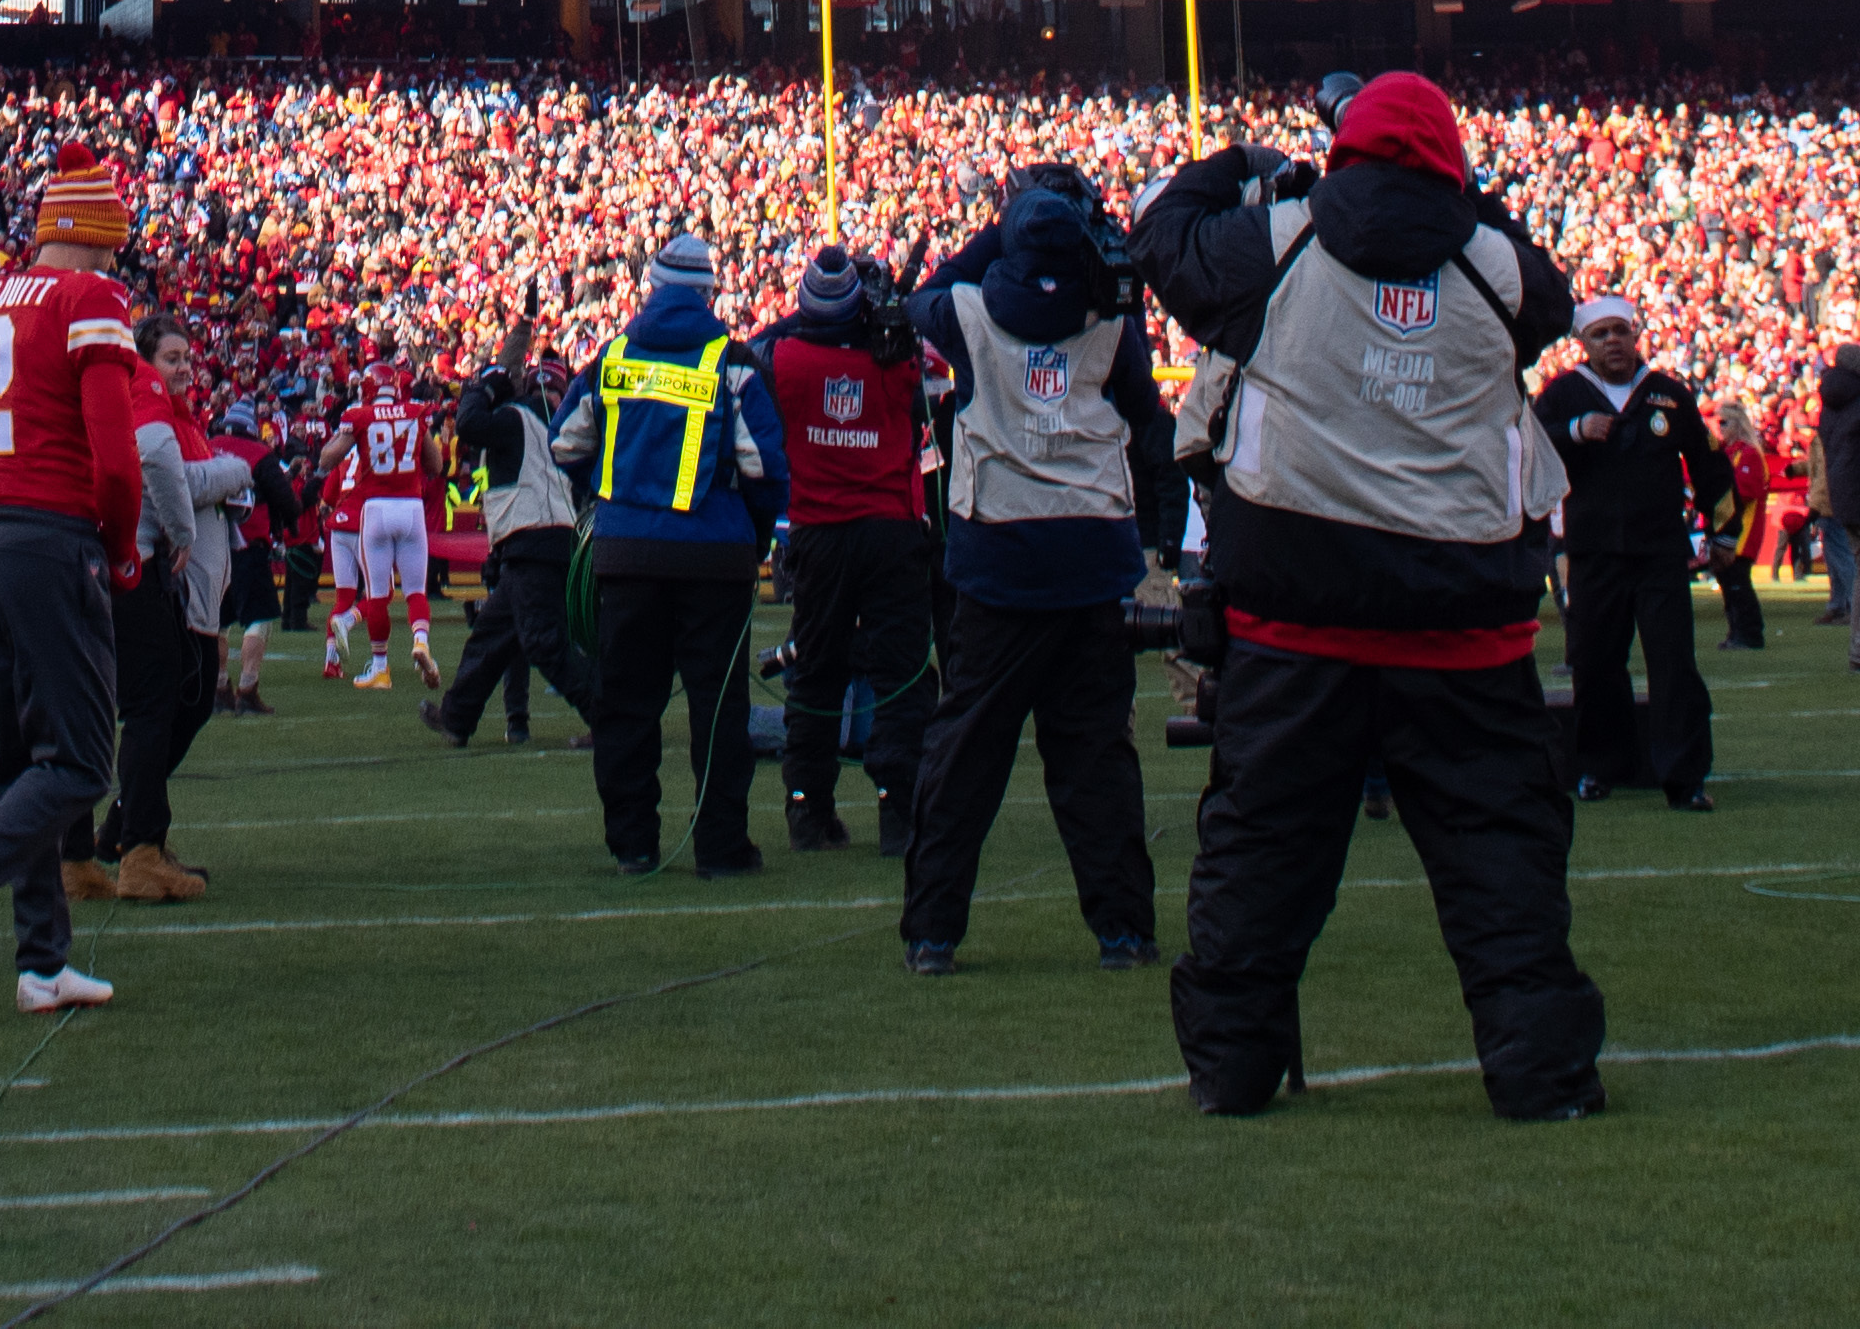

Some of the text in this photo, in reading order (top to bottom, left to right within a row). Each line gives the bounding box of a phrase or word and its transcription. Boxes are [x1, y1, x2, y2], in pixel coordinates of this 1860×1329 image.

[1381, 285, 1431, 324] NFL
[1363, 344, 1435, 382] MEDIA
[657, 376, 709, 397] SPORTS
[1029, 369, 1063, 395] NFL
[373, 405, 407, 420] KELCE
[828, 395, 859, 415] NFL
[367, 419, 419, 475] 87
[806, 426, 879, 449] TELEVISION
